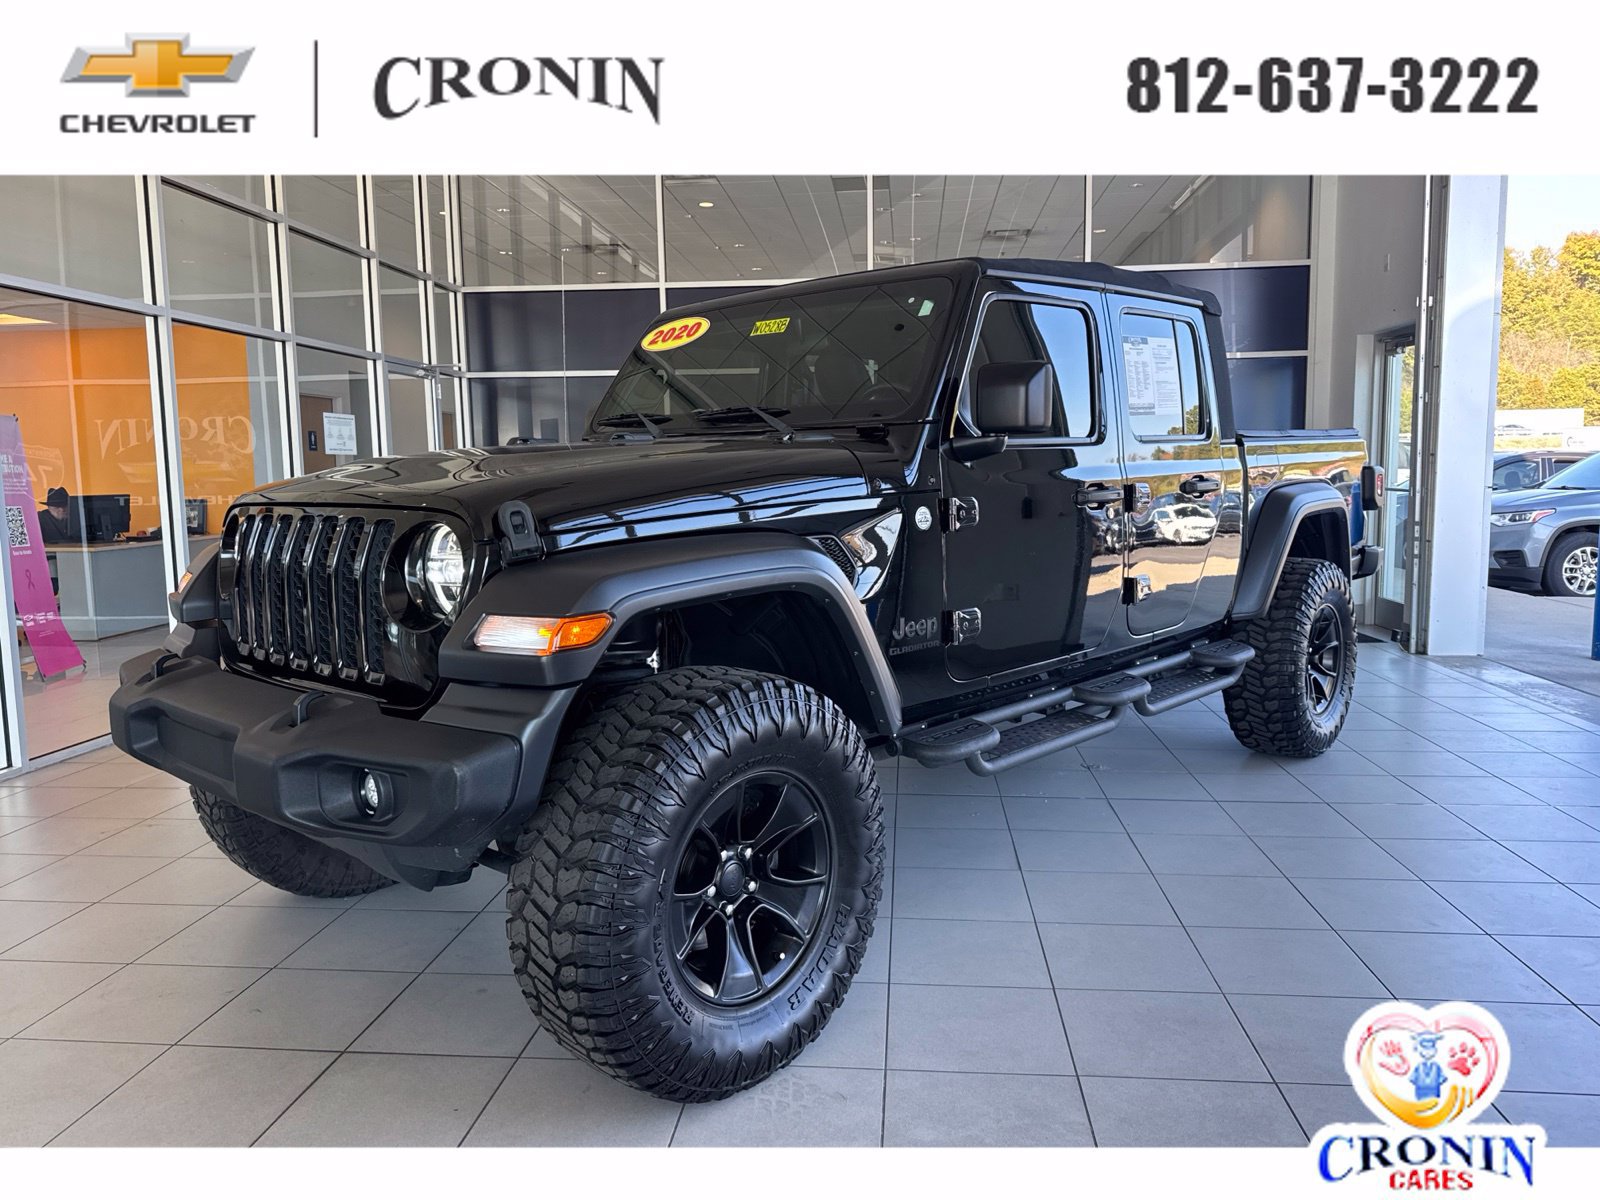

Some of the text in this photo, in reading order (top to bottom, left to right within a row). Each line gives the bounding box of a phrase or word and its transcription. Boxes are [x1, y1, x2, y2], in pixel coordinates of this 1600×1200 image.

[647, 320, 703, 346] 2020
[892, 617, 937, 640] Jeep
[889, 640, 940, 656] GLADIATOR
[786, 902, 852, 1012] RADAR
